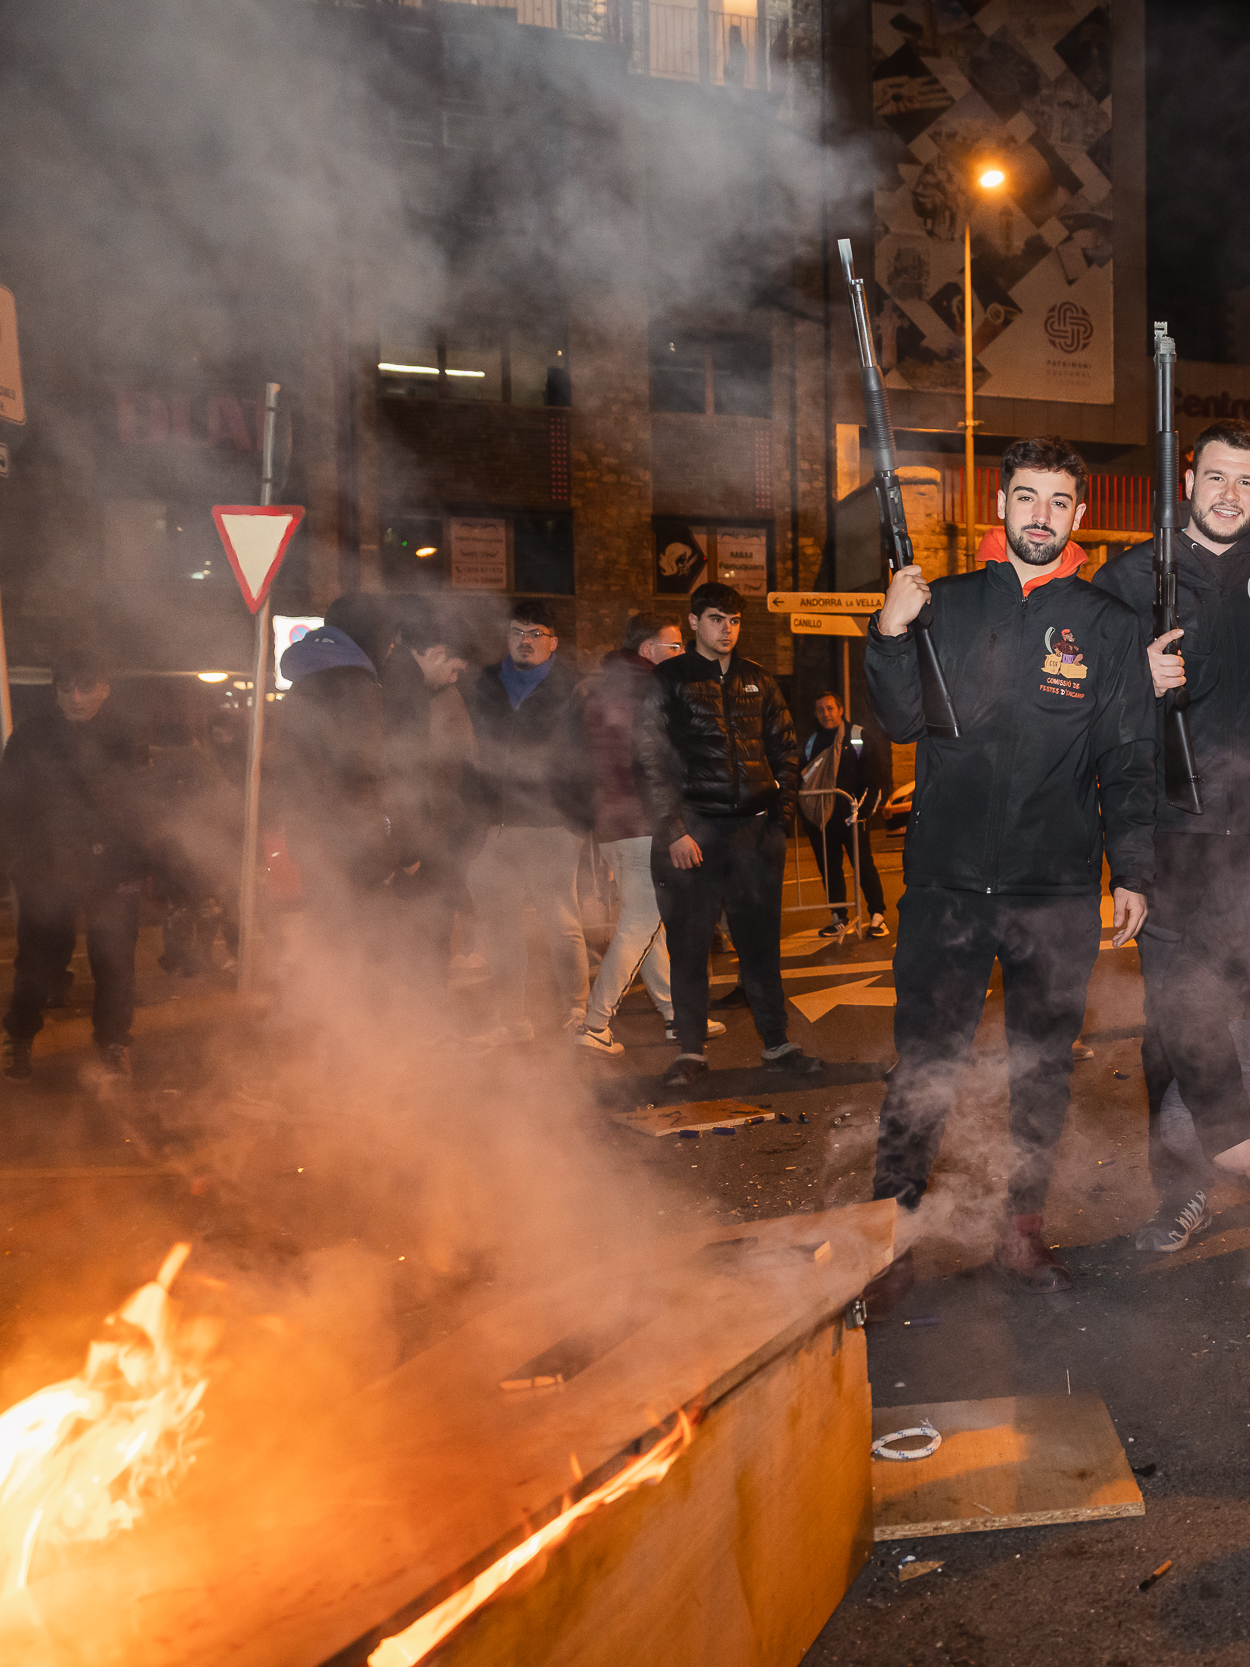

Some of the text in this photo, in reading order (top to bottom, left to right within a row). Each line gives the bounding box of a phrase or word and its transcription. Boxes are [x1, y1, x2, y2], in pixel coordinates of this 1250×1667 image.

[800, 598, 842, 607] ANDORRA
[856, 598, 882, 607] VELLA
[793, 618, 822, 628] CANILLO
